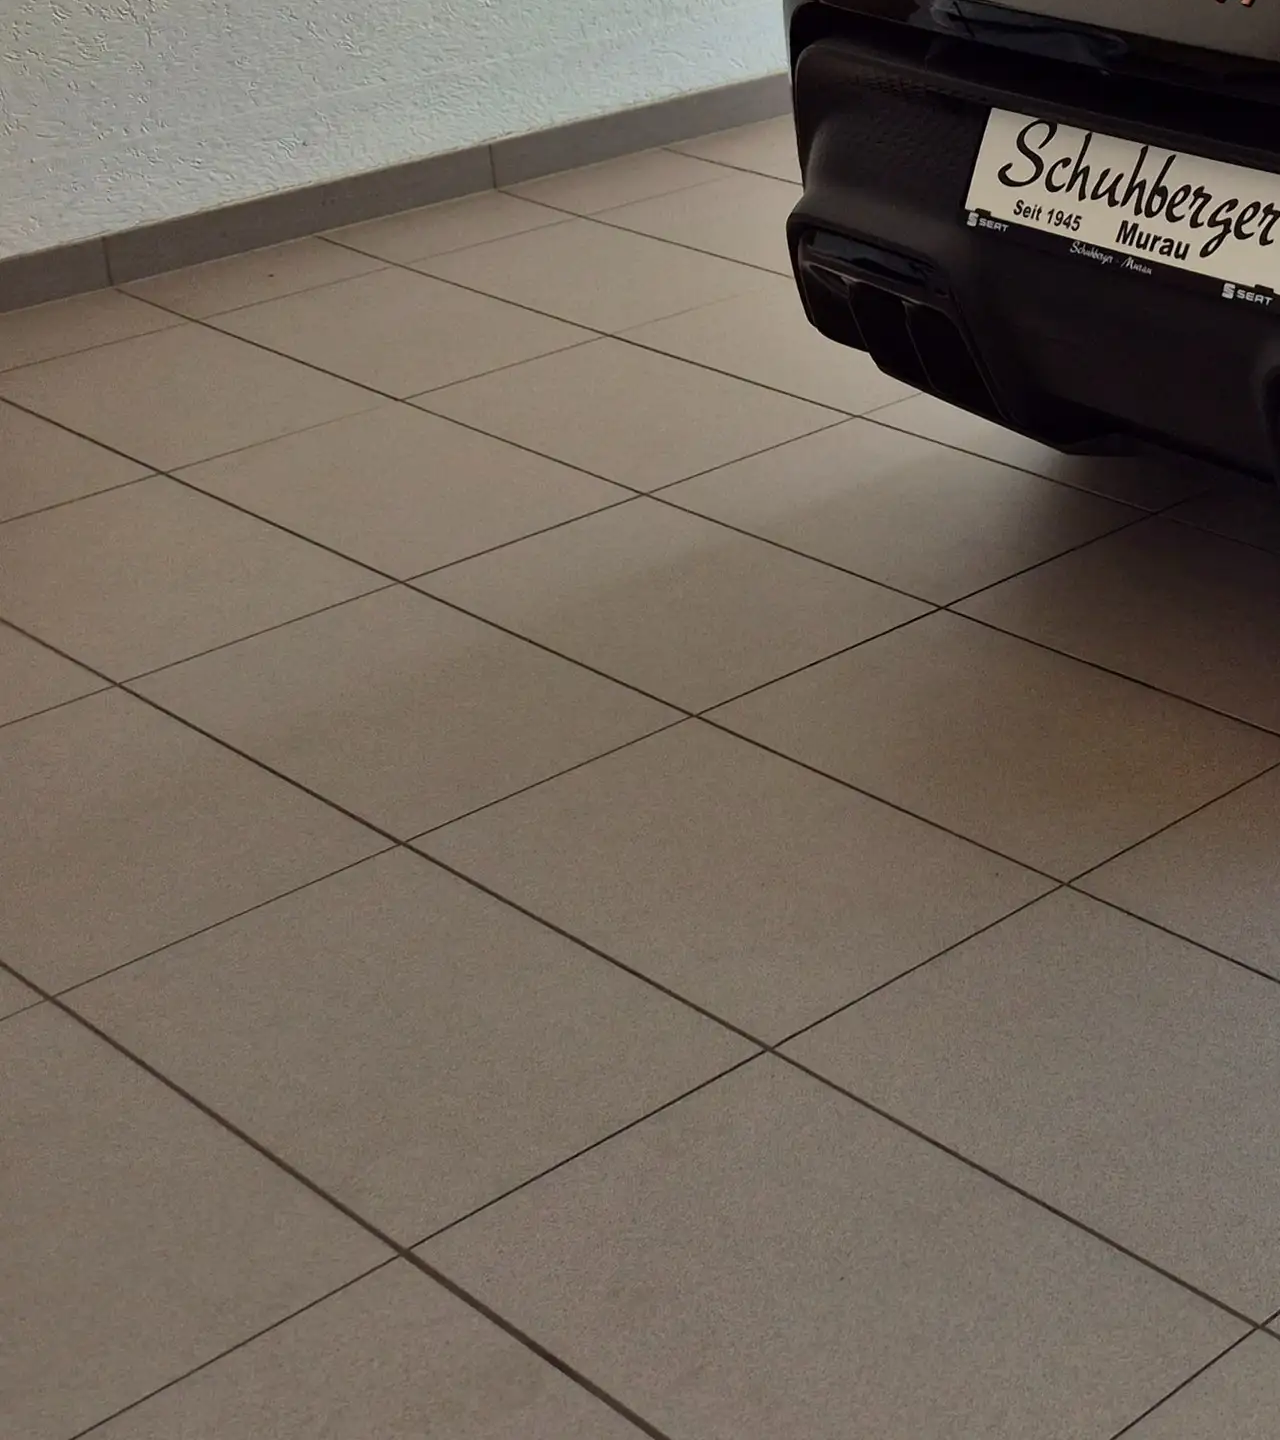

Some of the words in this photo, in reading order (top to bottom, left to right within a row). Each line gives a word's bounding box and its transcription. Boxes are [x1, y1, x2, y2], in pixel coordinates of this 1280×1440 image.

[978, 218, 1009, 233] SEAT
[1012, 200, 1043, 221] Seit
[1046, 207, 1083, 232] 1945
[1115, 220, 1192, 261] Murau
[1236, 289, 1273, 306] SEAT
